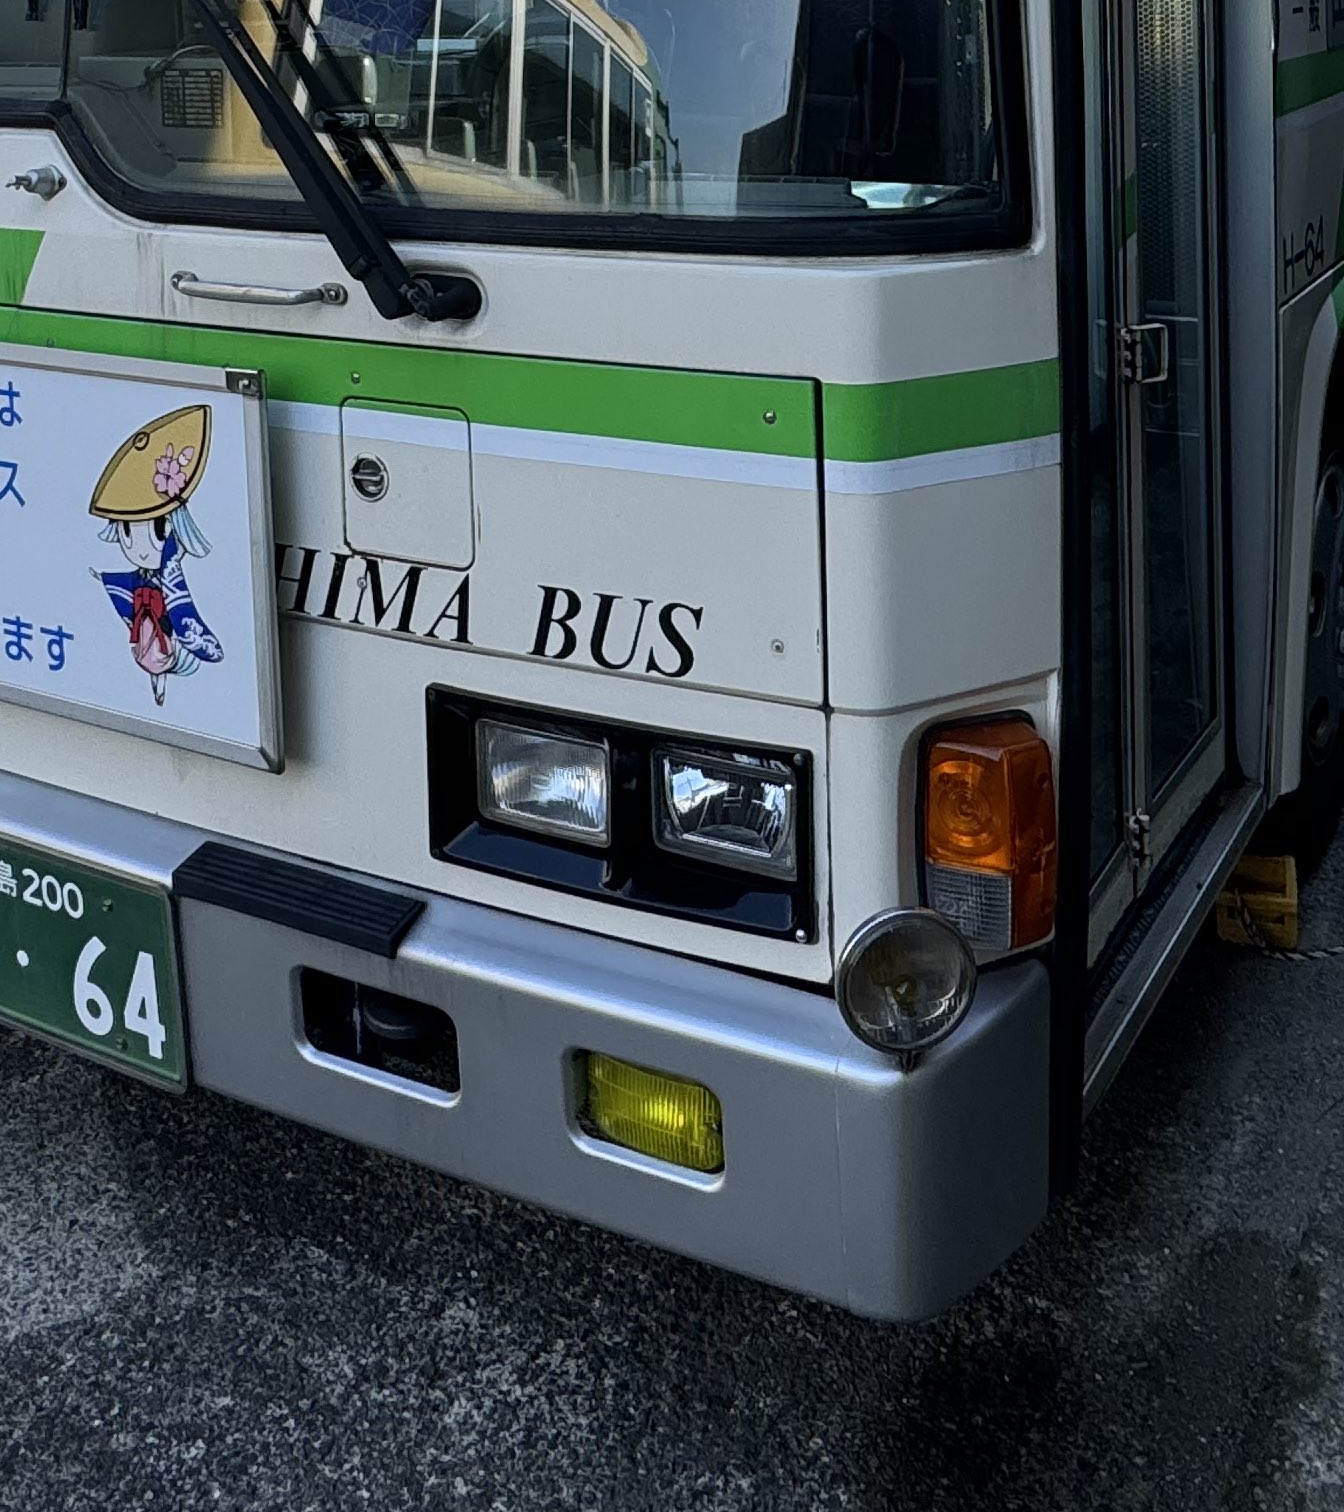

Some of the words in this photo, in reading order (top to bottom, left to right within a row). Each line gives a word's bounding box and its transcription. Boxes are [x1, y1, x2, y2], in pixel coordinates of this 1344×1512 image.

[1282, 214, 1325, 295] H-64
[527, 584, 704, 678] BUS
[73, 936, 166, 1059] 64
